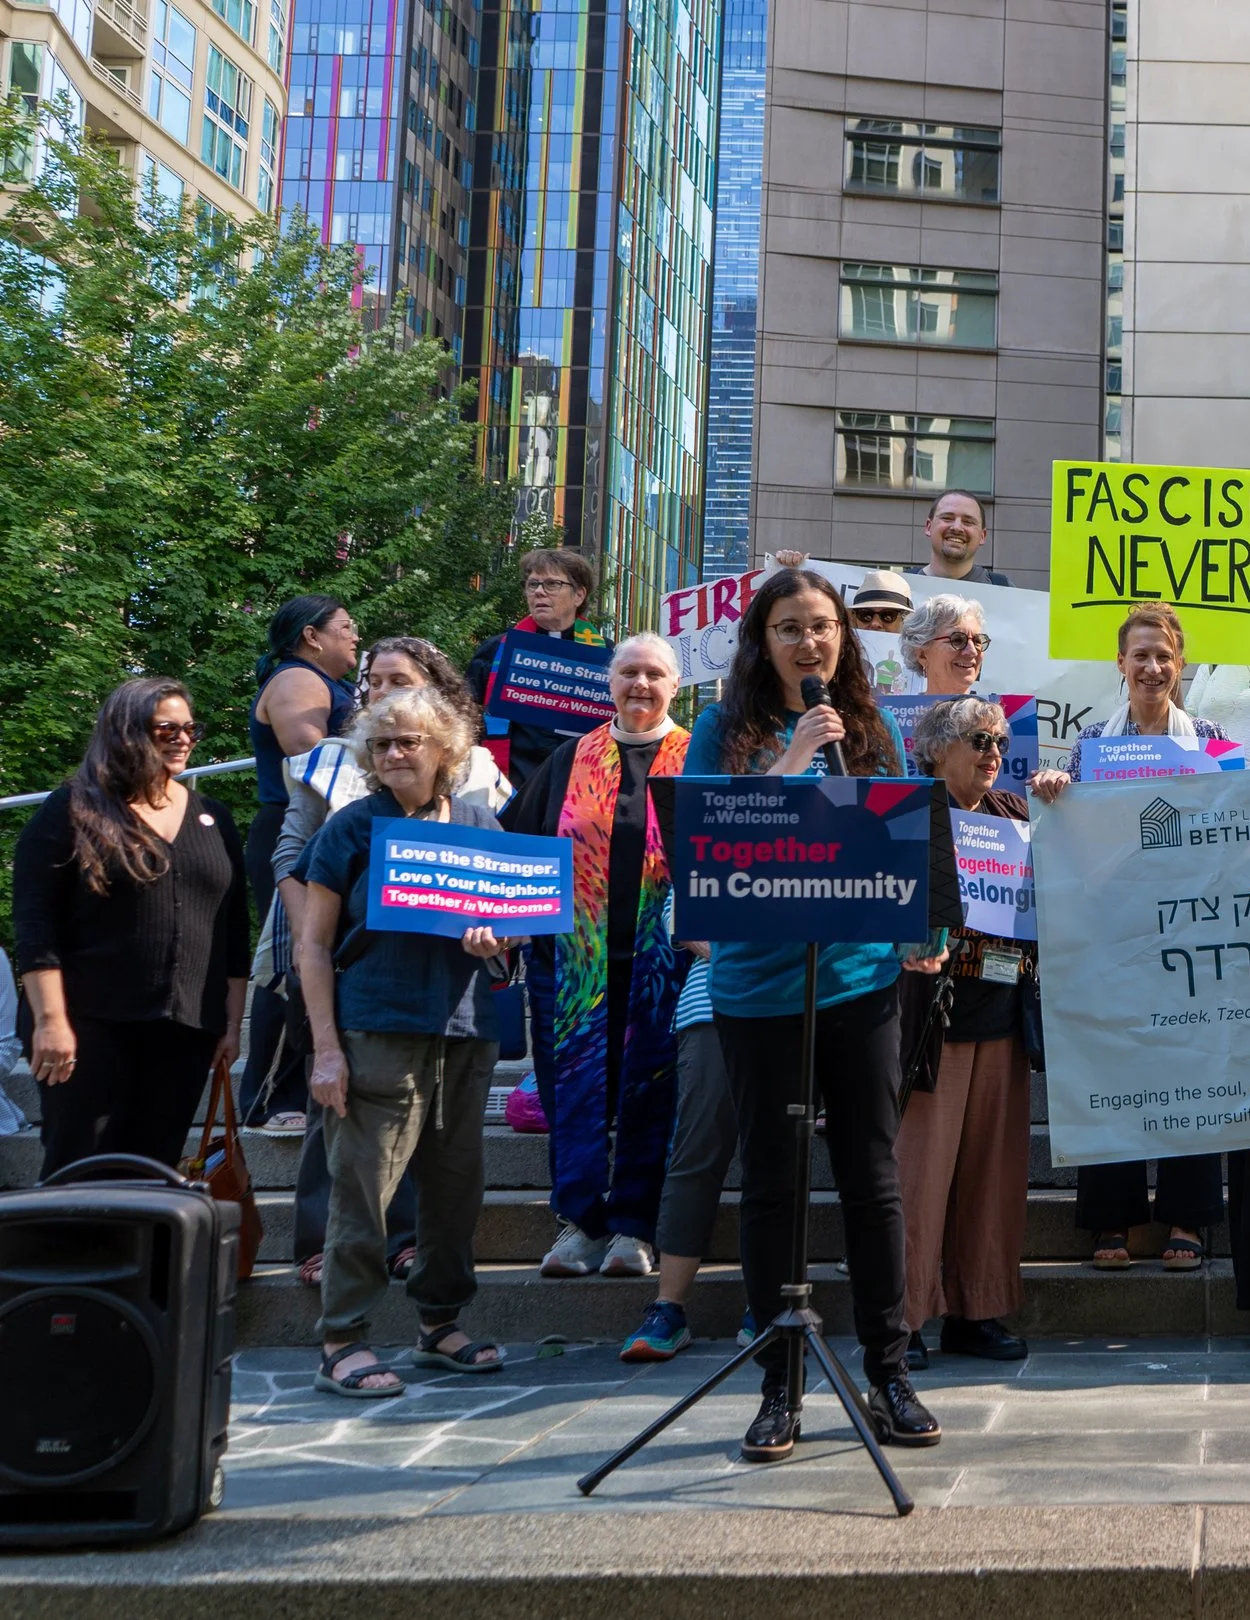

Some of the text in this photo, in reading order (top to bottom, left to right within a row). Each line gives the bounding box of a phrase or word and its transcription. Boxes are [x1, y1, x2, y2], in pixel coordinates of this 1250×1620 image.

[515, 653, 610, 683] Love the Stran
[510, 673, 613, 702] Love Your Neigh
[506, 688, 616, 718] Together in Welcom
[1099, 743, 1152, 756] Together
[1107, 752, 1162, 762] Welcome
[1092, 766, 1176, 781] Together
[702, 792, 786, 810] Together
[703, 810, 800, 824] in Welcome
[958, 821, 999, 838] Together
[1189, 825, 1250, 846] BETH
[689, 835, 842, 868] Together
[962, 835, 1005, 852] Welcome
[390, 844, 559, 877] Love the Stranger.
[1019, 862, 1033, 878] in
[389, 868, 561, 898] Love Your Neighbor.
[689, 870, 917, 905] in Community
[958, 873, 1036, 913] Belongi
[387, 889, 462, 909] Together
[463, 899, 476, 911] in
[1157, 896, 1220, 935] צדק
[1150, 1010, 1211, 1027] Tzedek,
[1089, 1089, 1170, 1111] Engaging
[1175, 1086, 1202, 1101] the
[1207, 1081, 1246, 1098] soul,
[1143, 1117, 1158, 1132] in
[1162, 1114, 1190, 1130] the
